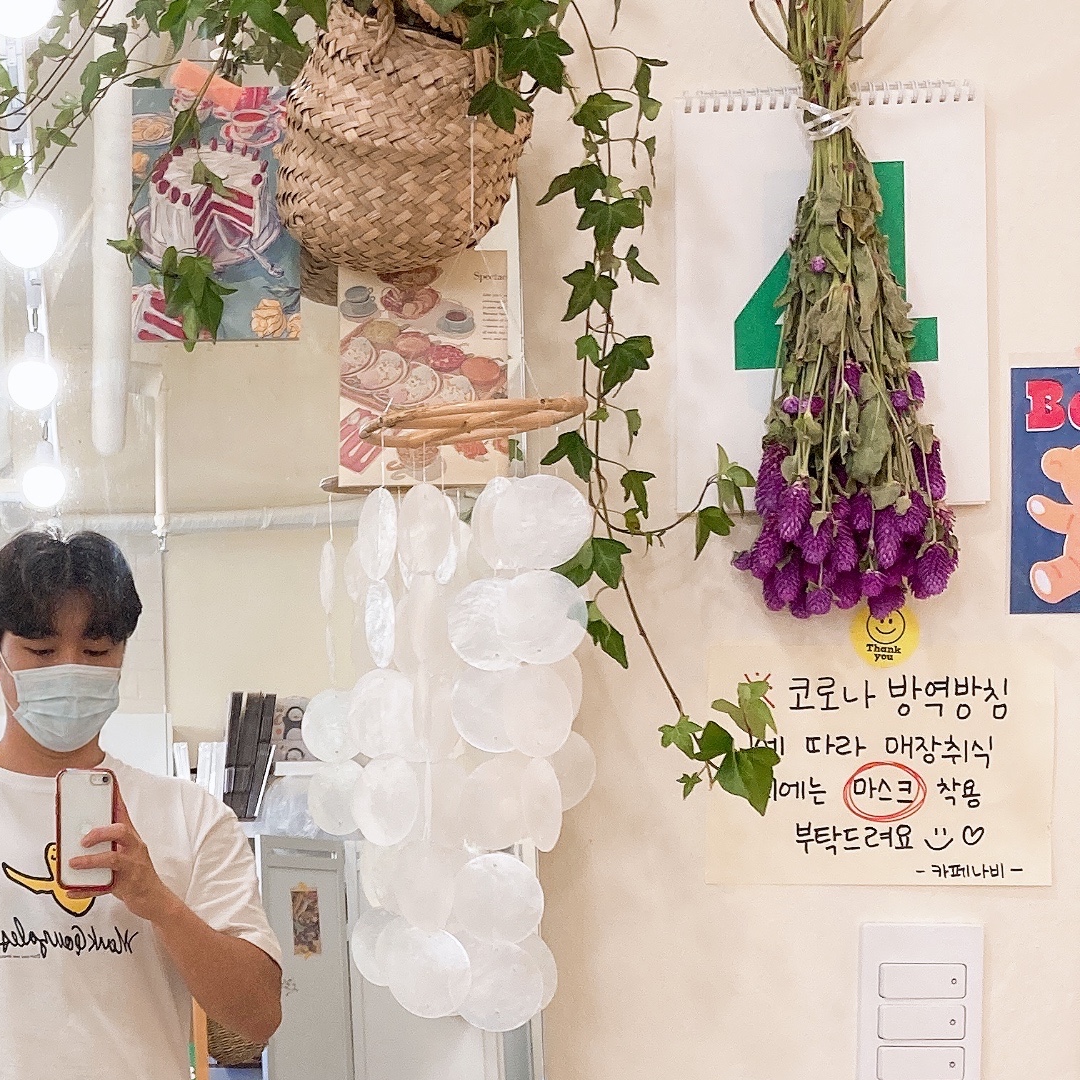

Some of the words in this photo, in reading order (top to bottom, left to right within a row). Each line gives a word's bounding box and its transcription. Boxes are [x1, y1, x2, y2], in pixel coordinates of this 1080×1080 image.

[866, 643, 902, 654] Thank
[874, 653, 894, 662] you
[788, 676, 876, 711] 코로나
[888, 673, 1008, 719] 방역방침
[805, 734, 867, 757] 따라
[885, 734, 994, 768] 매장취식
[769, 776, 827, 805] 에는
[853, 777, 914, 804] 마스크
[936, 778, 981, 808] 착용
[795, 822, 914, 855] 부탁드려요
